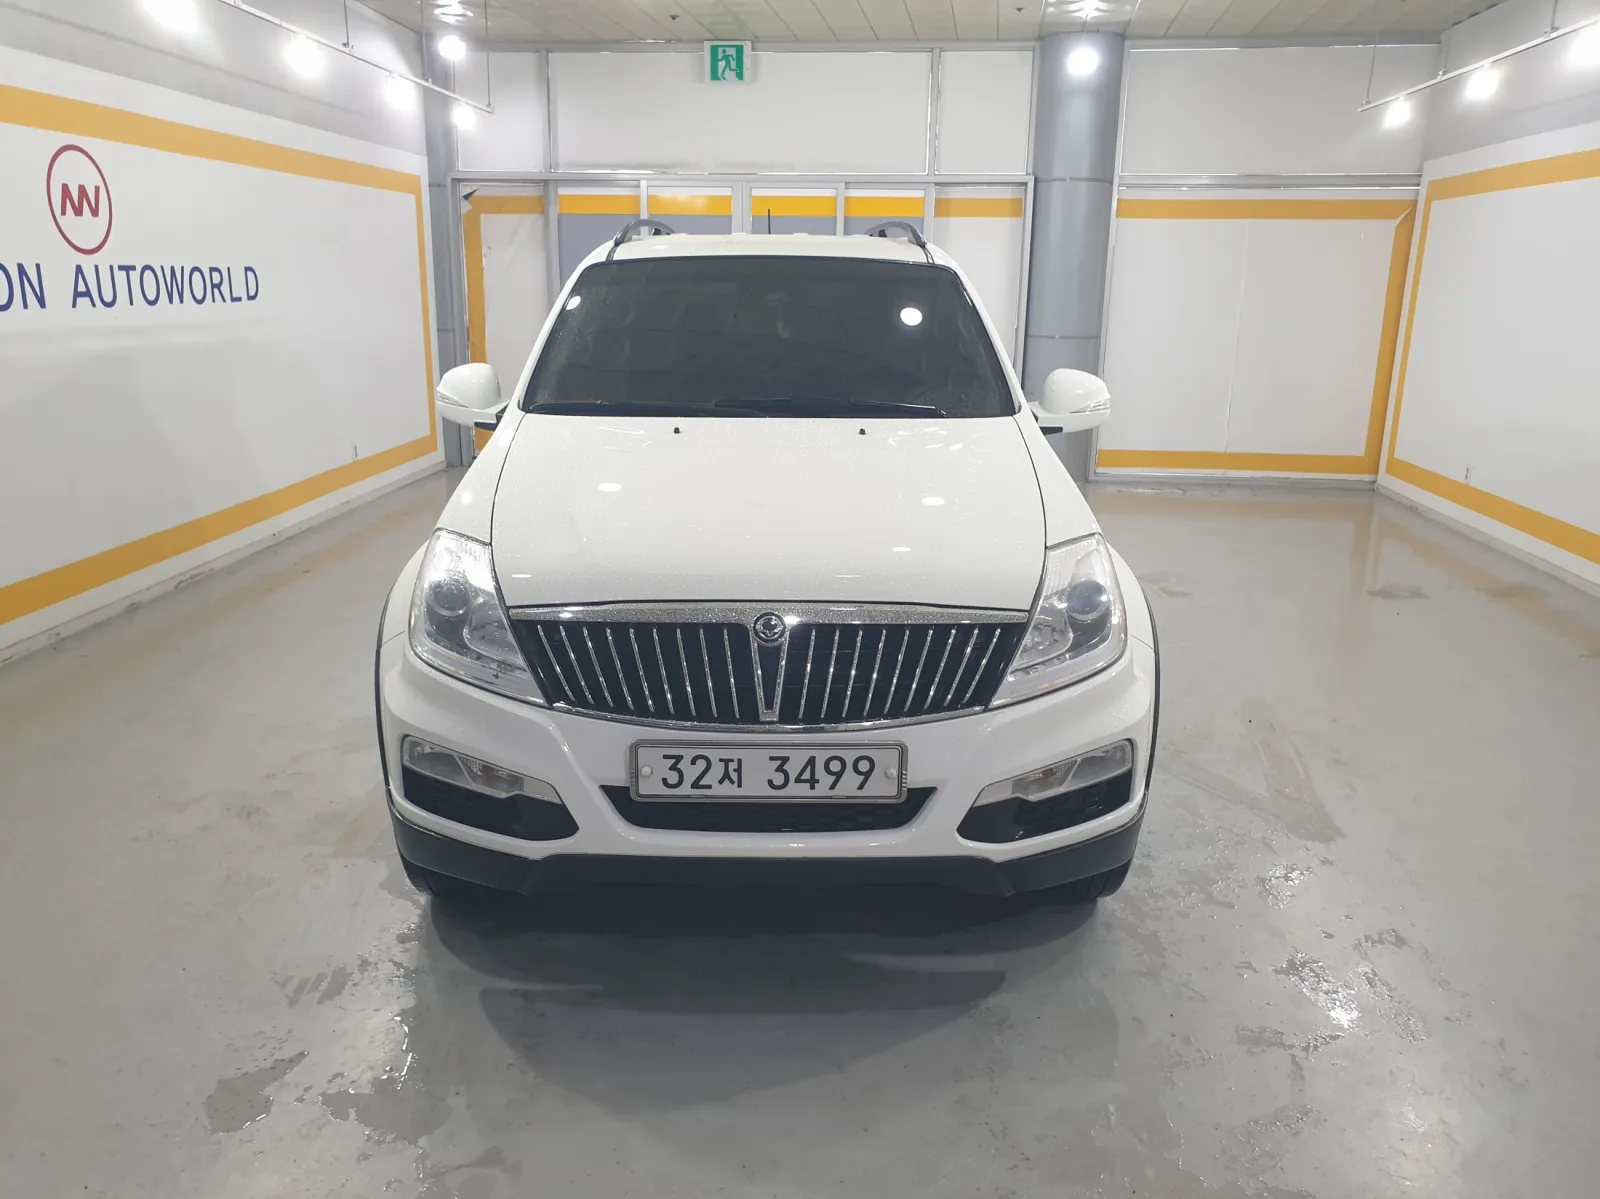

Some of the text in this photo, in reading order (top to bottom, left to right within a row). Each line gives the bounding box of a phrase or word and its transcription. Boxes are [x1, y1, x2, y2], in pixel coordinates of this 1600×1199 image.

[71, 264, 259, 308] AUTOWORLD
[661, 753, 876, 791] 32저 3499
